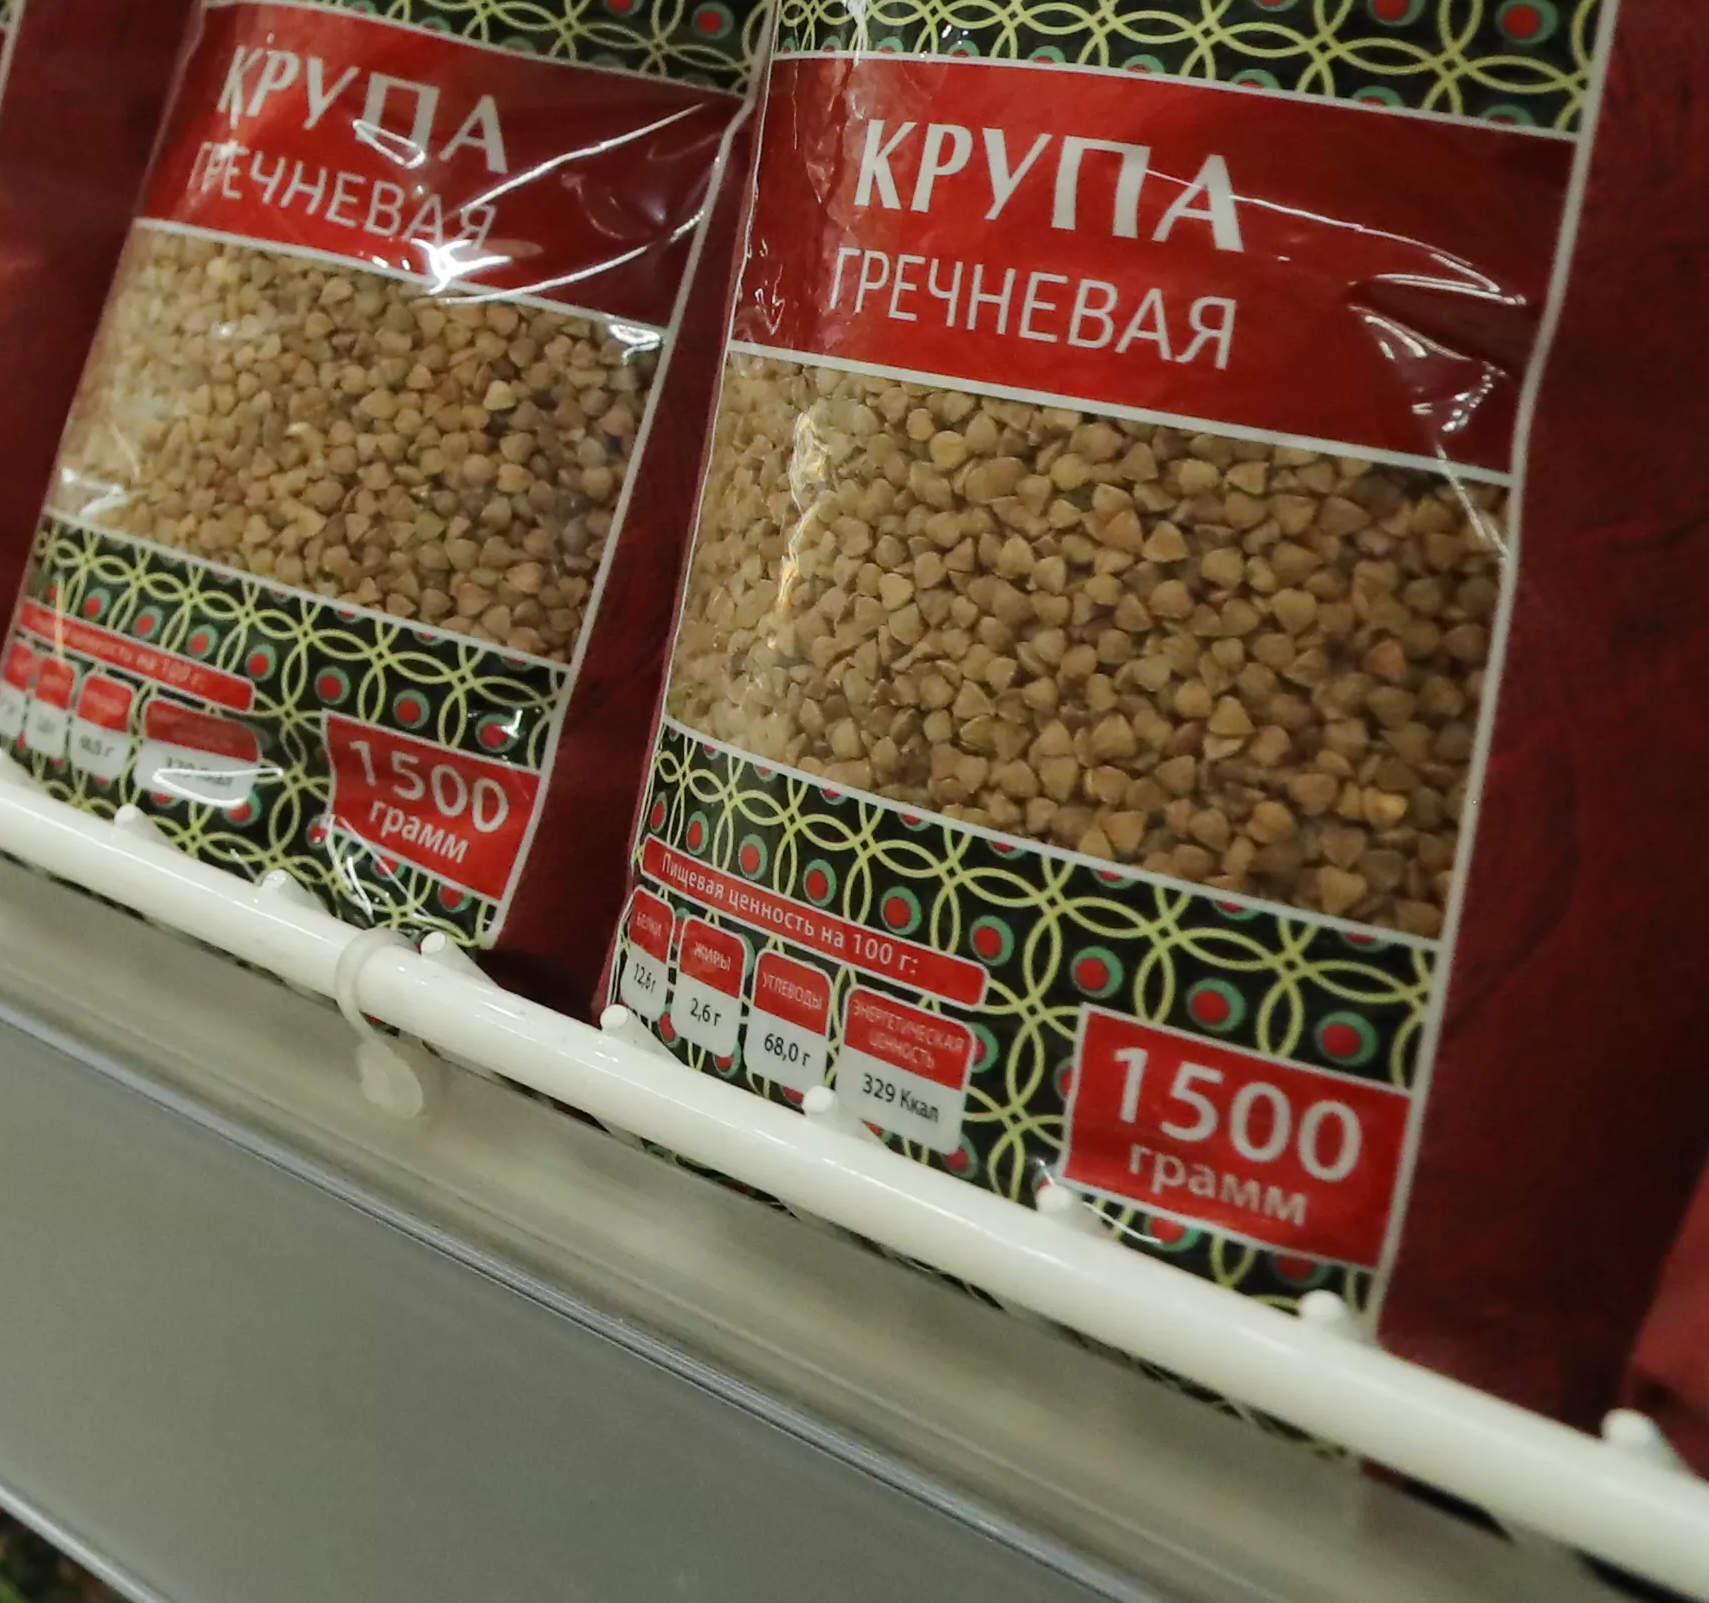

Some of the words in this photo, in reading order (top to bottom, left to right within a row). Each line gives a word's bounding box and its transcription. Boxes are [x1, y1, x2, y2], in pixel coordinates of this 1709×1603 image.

[216, 44, 508, 174] КРУПА
[186, 140, 499, 250] ГРЕЧНЕВАЯ
[851, 118, 1244, 254] КРУПА
[827, 246, 1238, 370] ГРЕЧНЕВАЯ
[348, 740, 510, 834] 1500
[369, 798, 470, 865] грамм
[661, 853, 725, 901] Пищевая
[729, 887, 815, 938] ценность
[820, 926, 845, 950] на
[853, 932, 893, 969] 100
[693, 941, 731, 972] ЖИРЫ
[690, 997, 711, 1023] 2,6
[763, 1032, 800, 1064] 68,0
[862, 1073, 897, 1104] 329
[899, 1093, 940, 1125] Ккал
[1113, 1046, 1363, 1183] 1500
[1128, 1143, 1309, 1229] грамм
